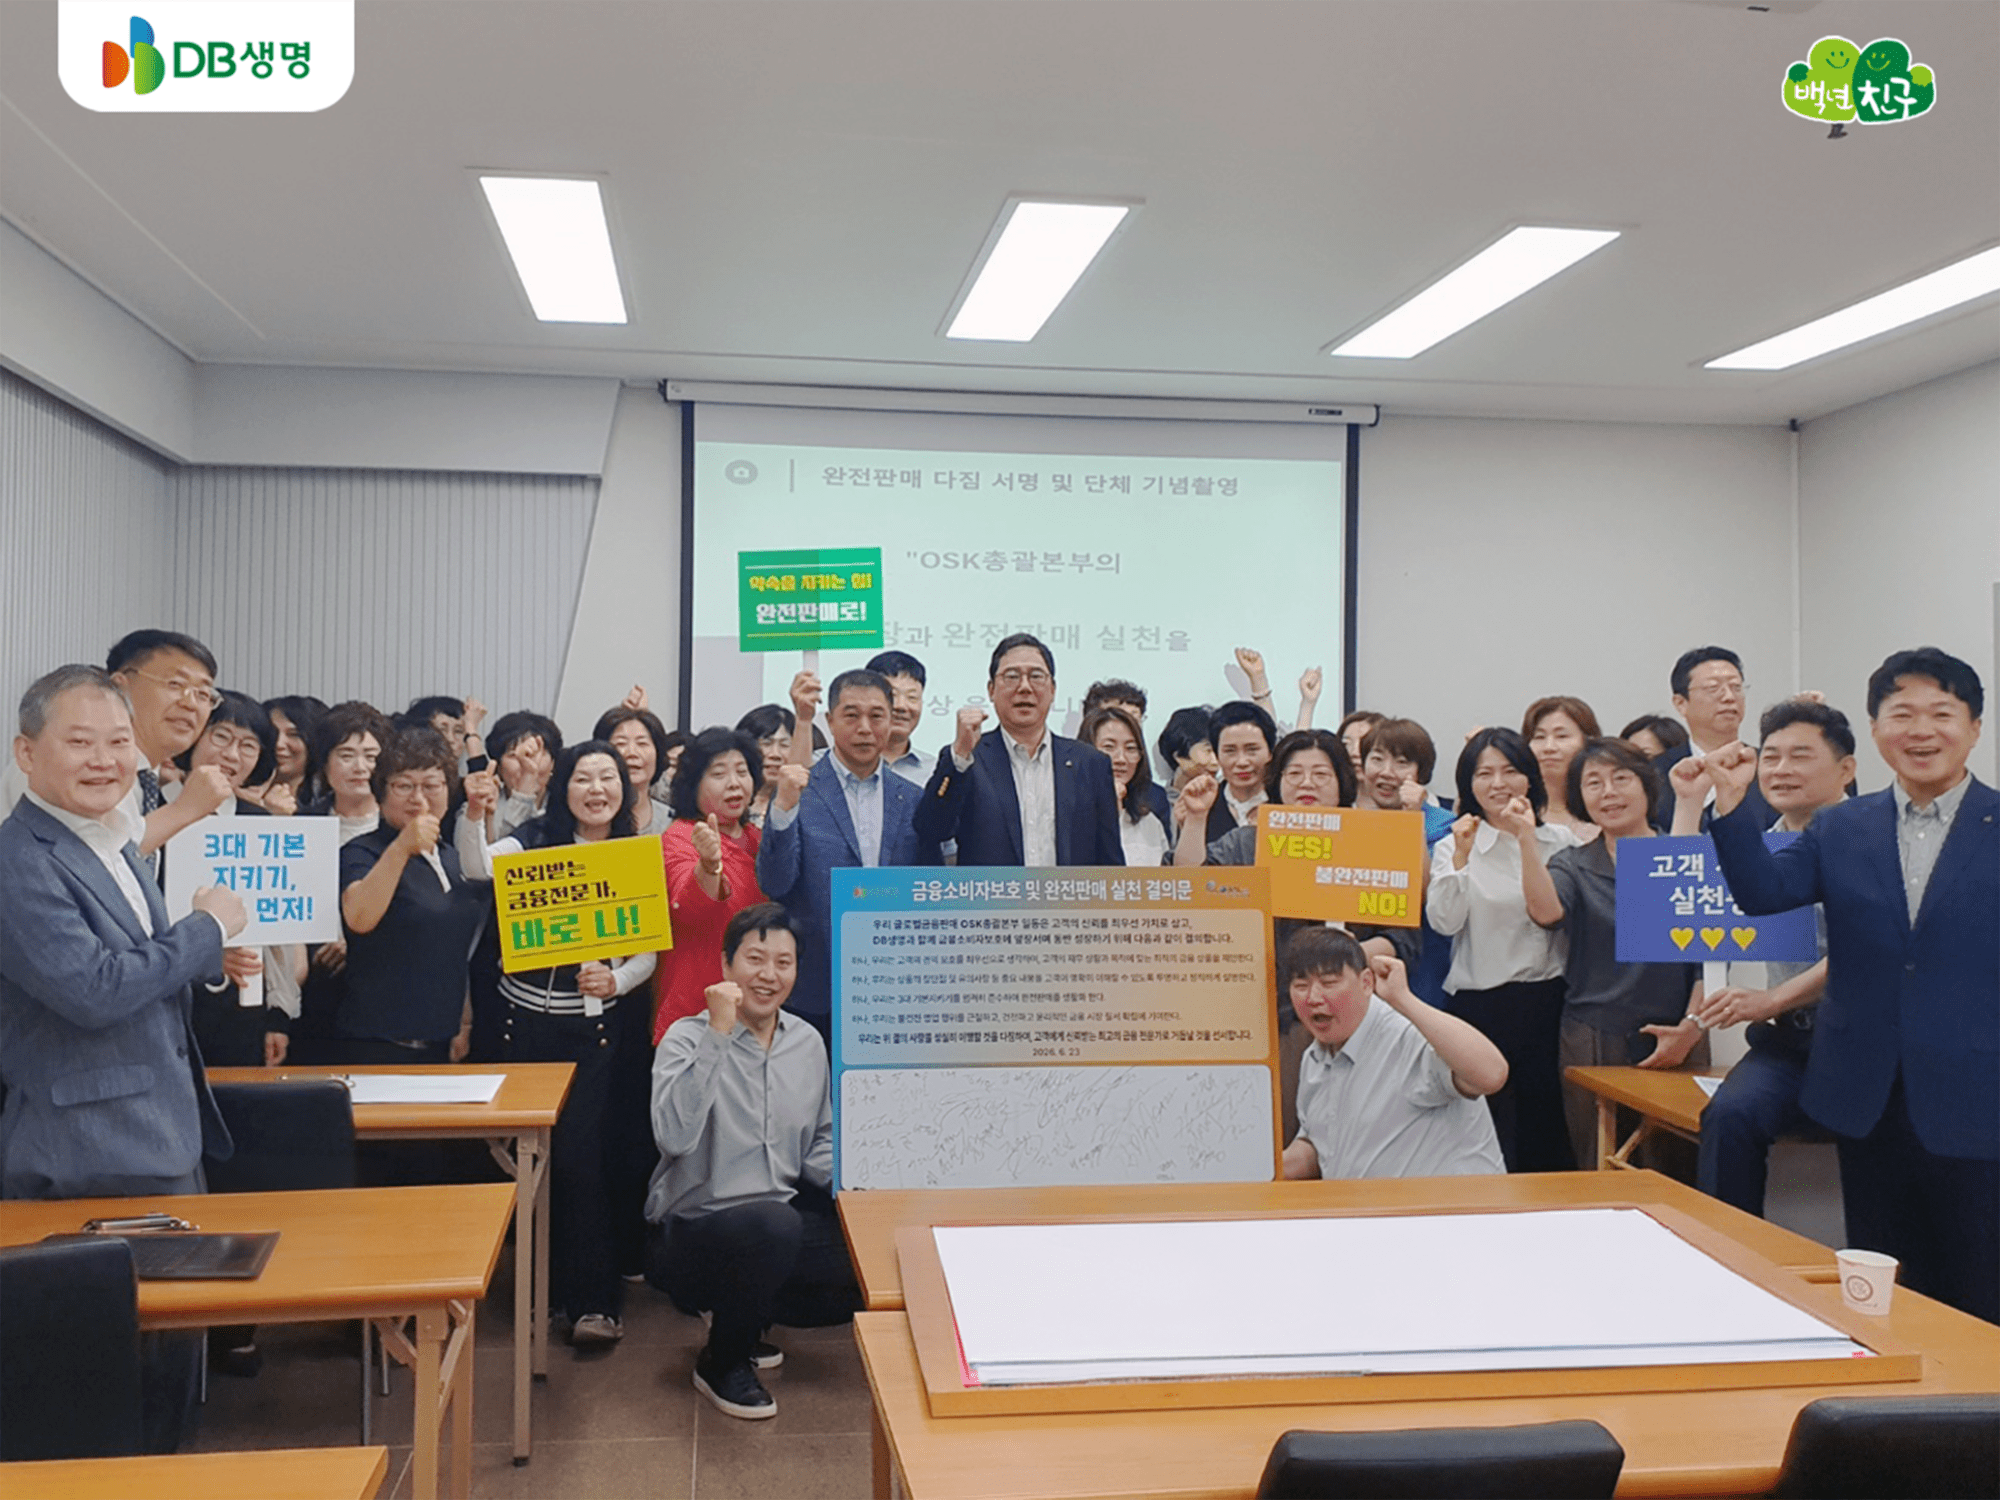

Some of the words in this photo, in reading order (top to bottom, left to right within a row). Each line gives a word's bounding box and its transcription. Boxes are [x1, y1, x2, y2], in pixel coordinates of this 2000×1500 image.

[821, 466, 922, 489] 완전판매
[933, 470, 980, 490] 다짐
[991, 472, 1039, 492] 서명
[1051, 473, 1073, 493] 및
[1084, 474, 1131, 494] 단체
[1142, 475, 1238, 497] 기념촬영
[906, 550, 1120, 574] "OSK총괄본부의
[749, 575, 796, 592] 약속을
[801, 574, 846, 590] 지키는
[756, 601, 867, 624] 완전판매로!
[1096, 625, 1191, 651] 실천을
[1268, 810, 1341, 832] 완전판매
[204, 833, 247, 859] 3대
[257, 833, 305, 859] 기본
[1267, 833, 1333, 860] YES!
[213, 865, 296, 891] 지키기,
[505, 860, 586, 887] 신뢰받는
[1315, 865, 1409, 889] 불완전판매
[1648, 853, 1705, 882] 고객
[507, 880, 617, 910] 금융전문가,
[911, 880, 1022, 901] 금융소비자보호
[1025, 880, 1041, 901] 및
[1044, 879, 1107, 901] 완전판매
[1110, 879, 1142, 901] 실천
[1146, 879, 1193, 901] 결의문
[256, 896, 314, 922] 먼저!
[1358, 890, 1408, 918] NO!
[511, 917, 583, 950] 바로
[594, 904, 641, 938] 나!
[1141, 918, 1167, 928] 가치로
[1068, 1048, 1080, 1056] 23
